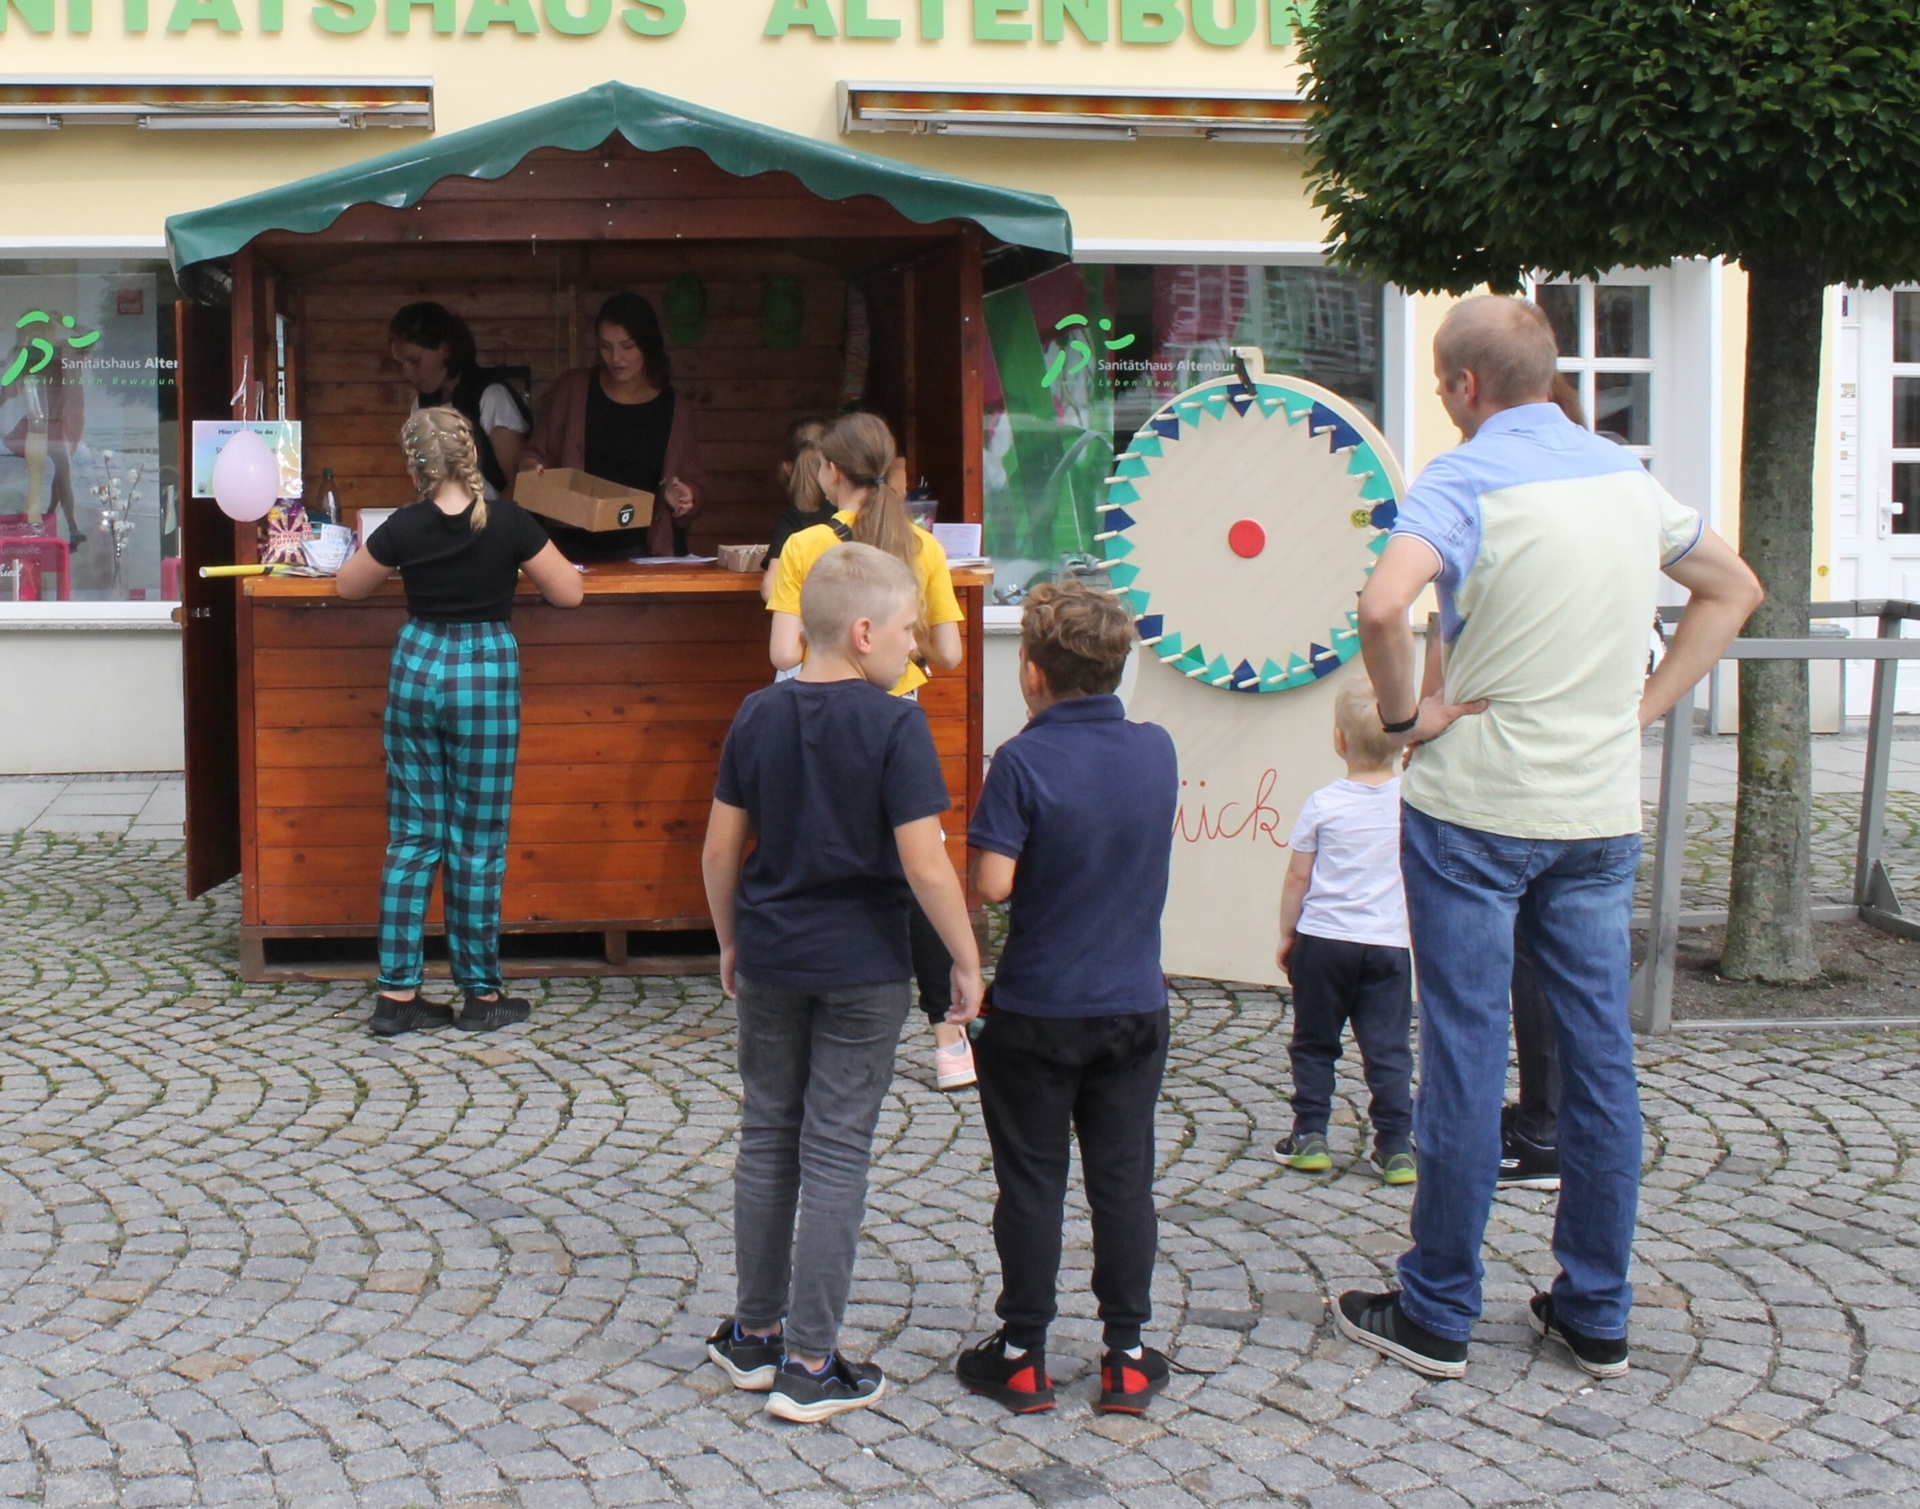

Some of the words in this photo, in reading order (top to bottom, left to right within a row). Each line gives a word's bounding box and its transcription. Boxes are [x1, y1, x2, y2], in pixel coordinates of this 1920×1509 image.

[61, 357, 140, 369] Sanitätshaus
[1098, 359, 1173, 371] Sanitätshaus
[1176, 359, 1236, 372] Altenbur
[112, 378, 175, 387] Bewegun
[1171, 768, 1289, 848] ück
